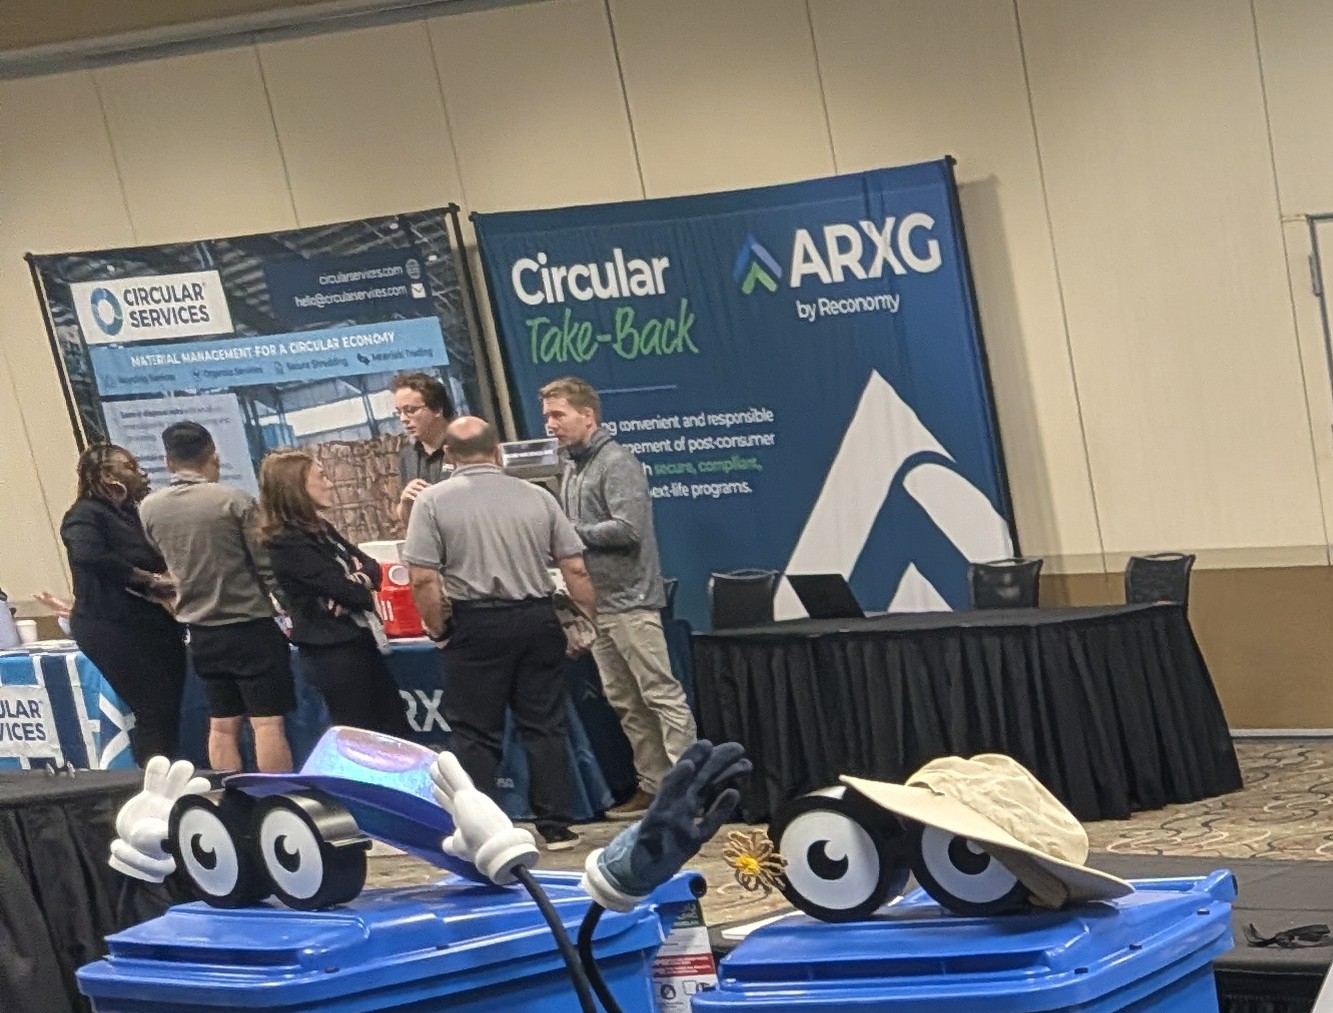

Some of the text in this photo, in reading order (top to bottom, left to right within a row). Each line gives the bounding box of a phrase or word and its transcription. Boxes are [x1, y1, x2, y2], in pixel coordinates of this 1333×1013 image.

[789, 212, 943, 290] ARXG
[319, 264, 403, 285] circularservices.com
[510, 248, 670, 305] Circular
[123, 283, 205, 306] CIRCULAR
[294, 284, 408, 308] hello@circularservices.com
[796, 291, 900, 321] by Reconomy
[129, 305, 210, 328] SERVICES
[525, 298, 700, 364] Take-Back
[131, 331, 396, 367] MATERIAL MANAGEMENT FOR A CIRCULAR ECONOMY
[619, 414, 680, 433] convenient
[682, 411, 706, 429] and
[707, 407, 774, 427] responsible
[673, 436, 685, 452] of
[687, 432, 776, 453] post-consumer
[654, 459, 697, 476] secure,
[650, 481, 752, 499] ext-life programs.
